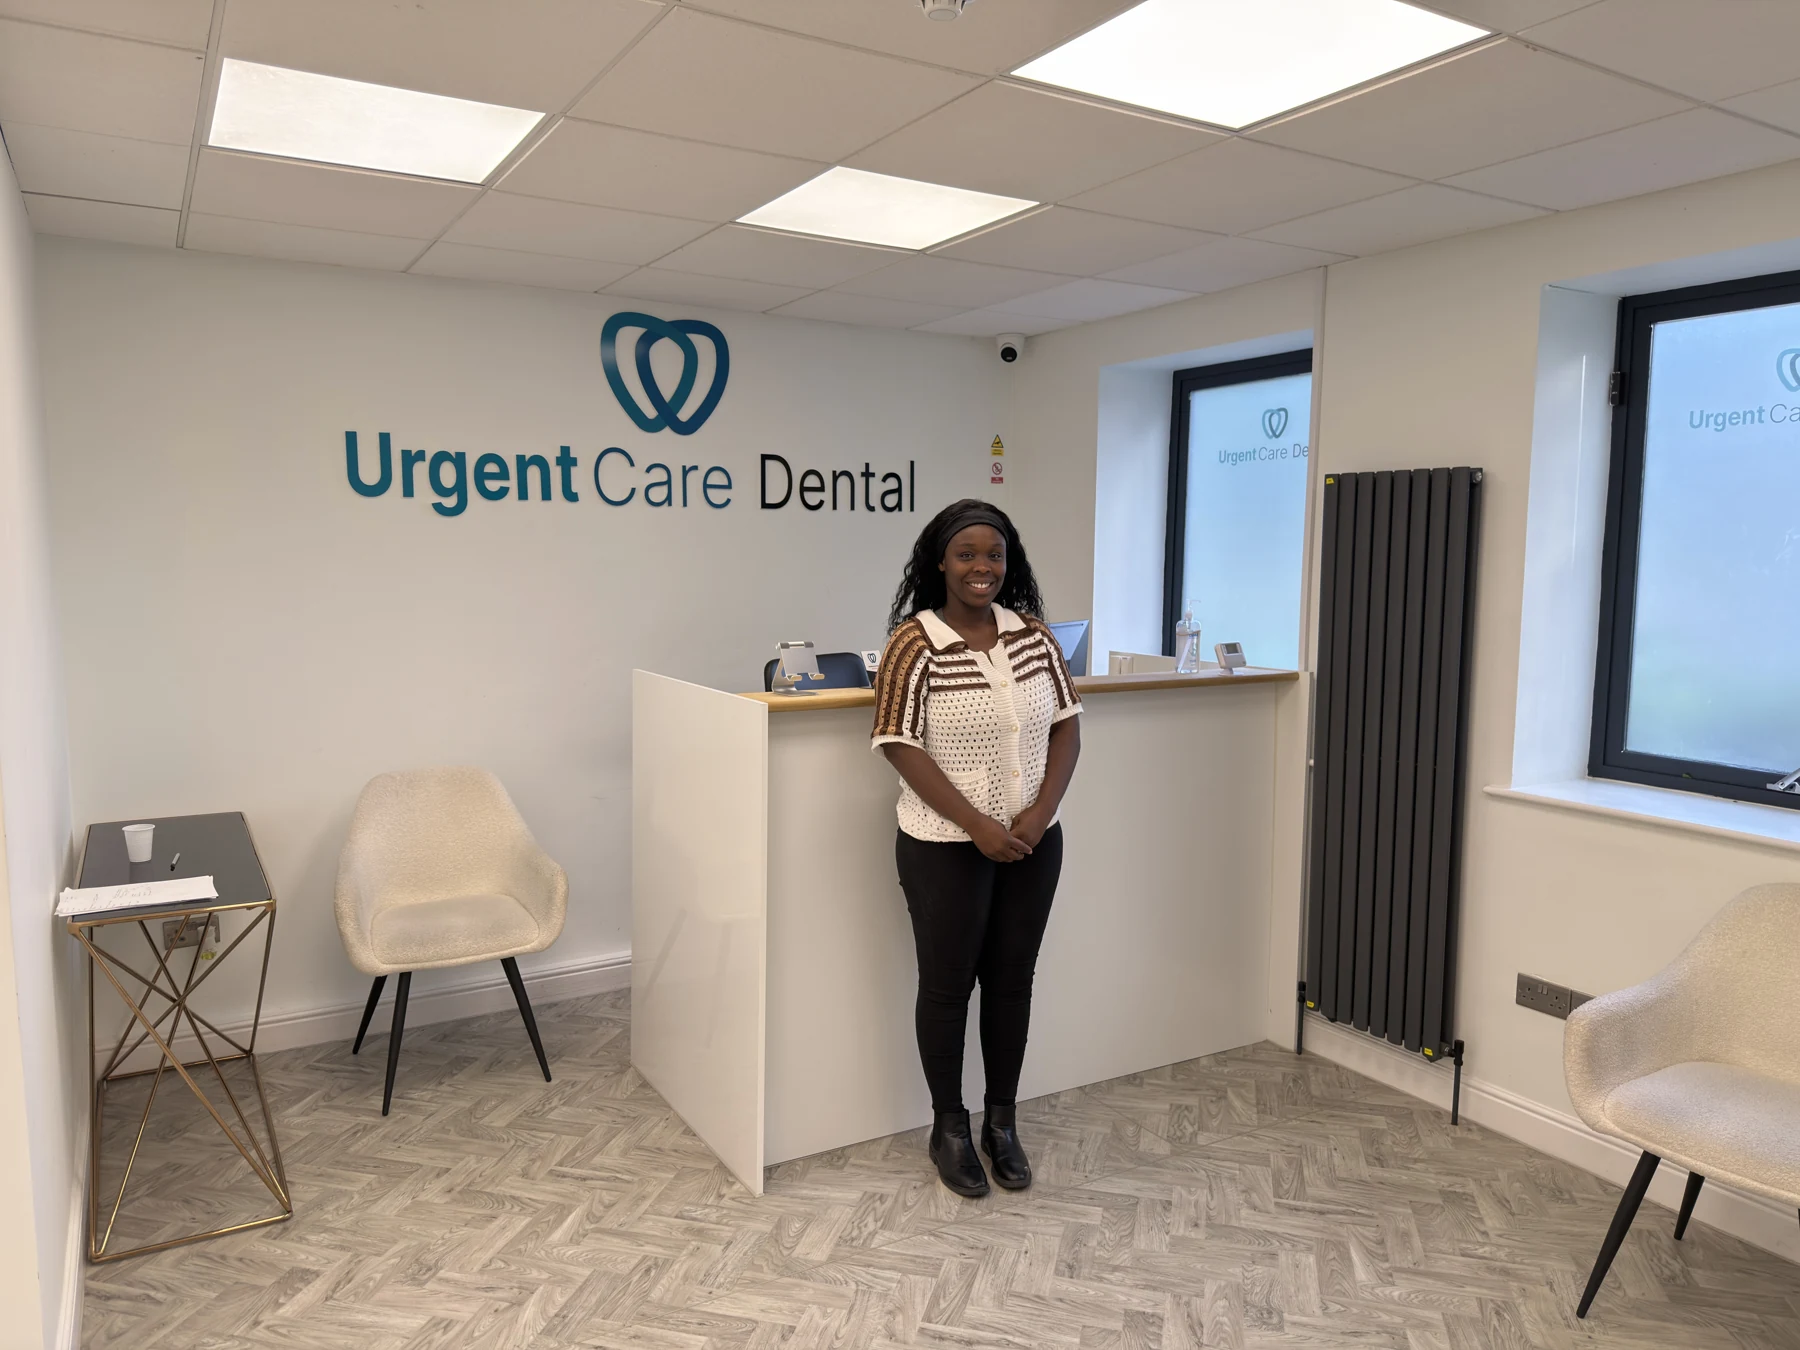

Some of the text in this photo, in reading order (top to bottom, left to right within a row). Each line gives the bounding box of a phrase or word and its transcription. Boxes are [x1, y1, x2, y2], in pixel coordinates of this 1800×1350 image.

[1689, 405, 1765, 432] Urgent
[1218, 448, 1257, 466] Urgent
[1258, 446, 1288, 461] Care
[345, 430, 915, 517] Urgent Care Dental
